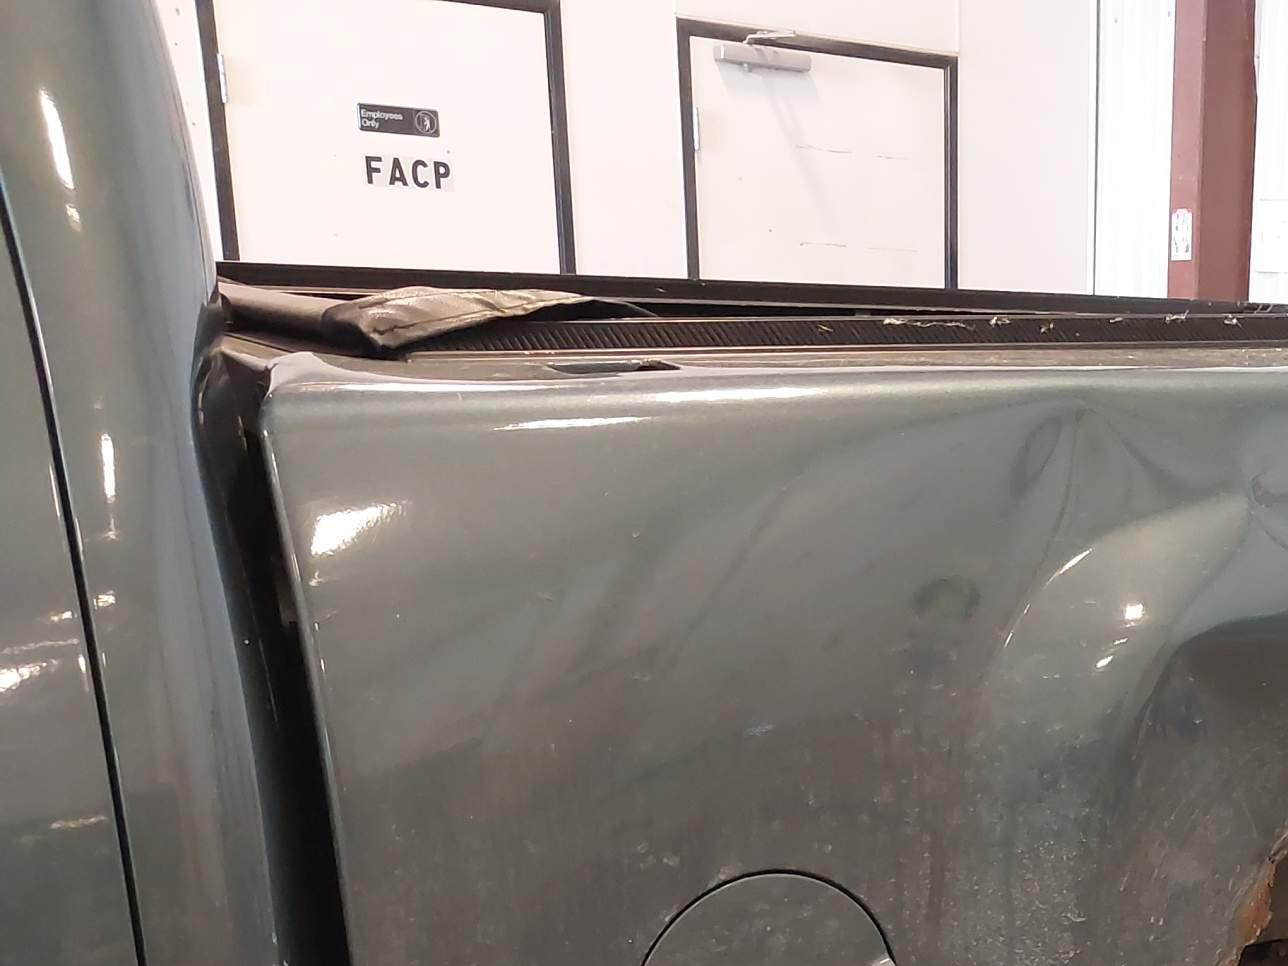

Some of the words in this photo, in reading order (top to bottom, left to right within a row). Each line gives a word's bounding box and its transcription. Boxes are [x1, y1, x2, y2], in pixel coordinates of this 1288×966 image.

[361, 109, 403, 121] Employees
[361, 119, 379, 129] Only
[365, 155, 450, 189] FACP
